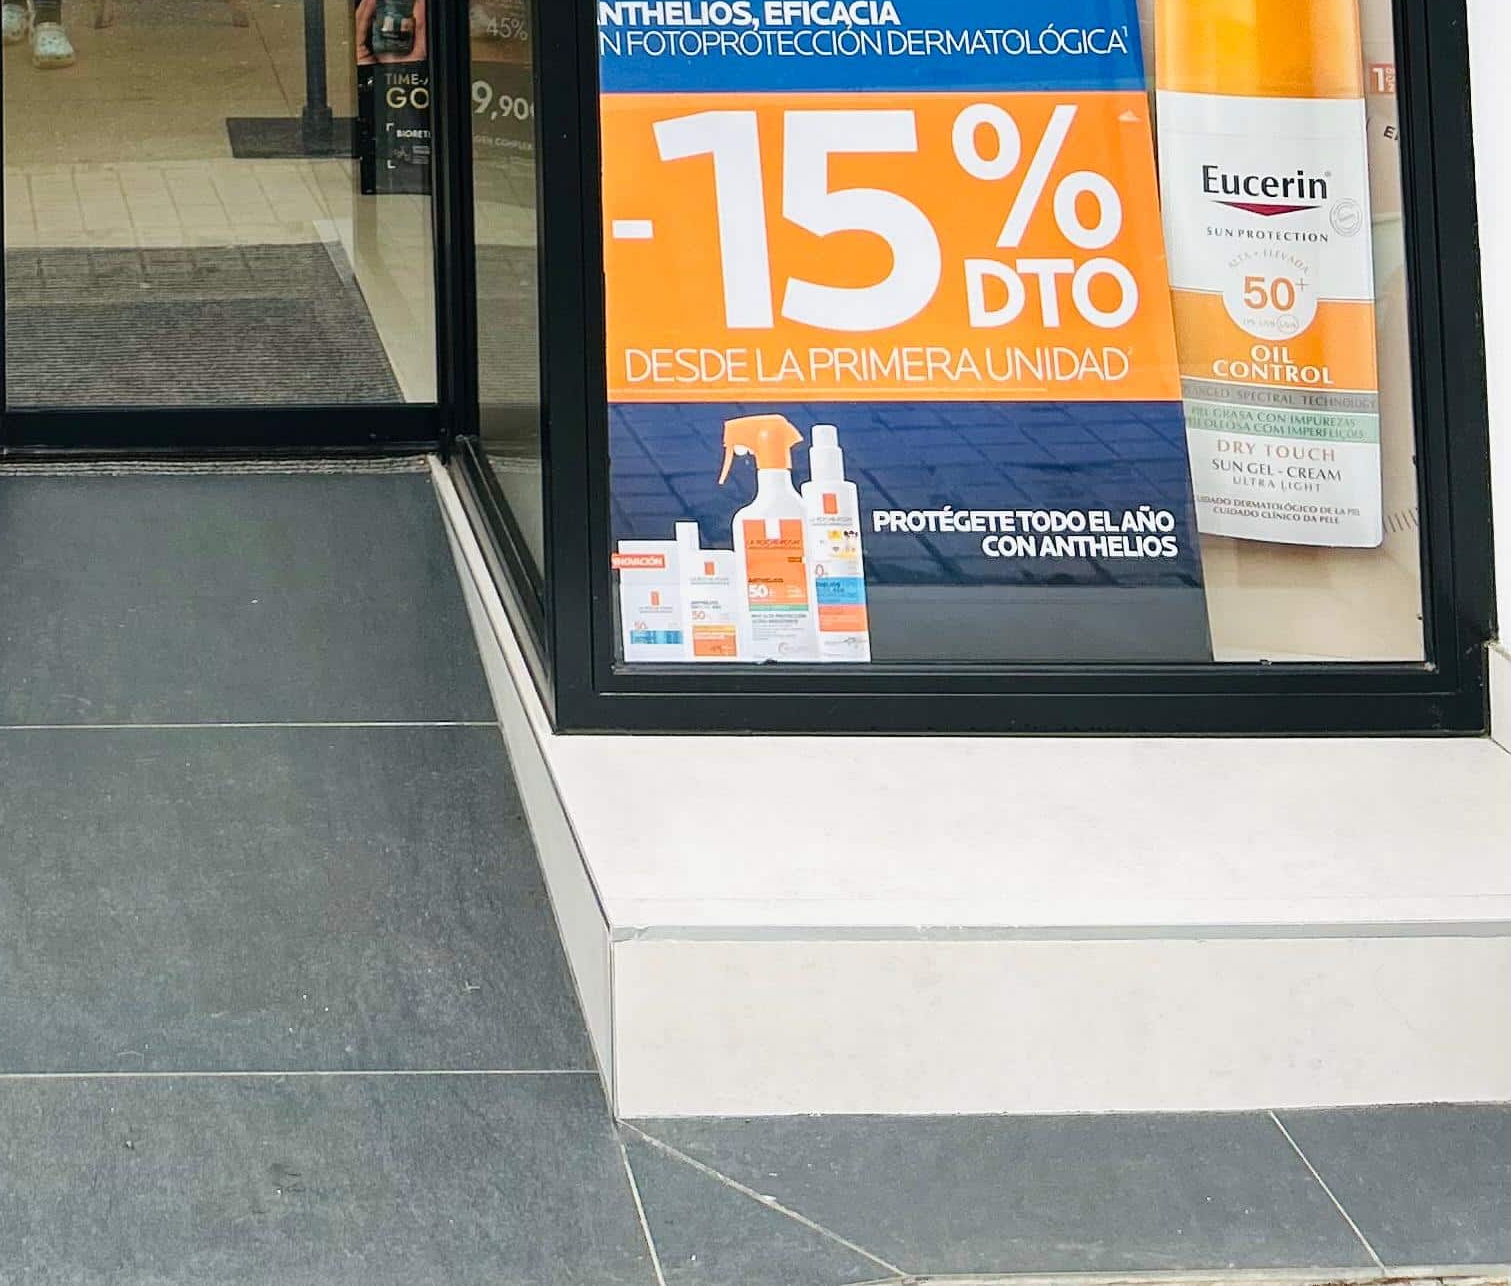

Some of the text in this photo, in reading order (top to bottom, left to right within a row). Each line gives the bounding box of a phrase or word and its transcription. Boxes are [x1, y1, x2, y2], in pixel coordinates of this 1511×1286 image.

[598, 0, 900, 30] NTHELIOS, EFICACIA
[627, 22, 882, 57] FOTOPROTECCIÓN
[1202, 164, 1328, 199] Eucerin
[612, 102, 1123, 332] -15%
[1206, 226, 1329, 242] SUN PROTECTION
[964, 257, 1139, 328] DTO
[624, 347, 748, 383] DESDE
[757, 348, 805, 381] LA
[811, 347, 982, 382] PRIMERA
[1250, 344, 1293, 364] OIL
[1212, 359, 1335, 385] CONTROL
[1214, 407, 1254, 422] GRASA
[1257, 411, 1287, 424] CON
[1291, 416, 1357, 428] IMPUREZAS
[1254, 422, 1285, 435] COM
[1216, 438, 1336, 463] DRY TOUCH
[1212, 459, 1342, 482] SUN GEL CREAM
[1233, 477, 1321, 493] ULTRA LIGHT
[872, 505, 1175, 533] PROTÉGETE TODO EL AÑO
[1213, 507, 1259, 518] CUIDADO
[981, 535, 1178, 558] CON ANTHELIOS
